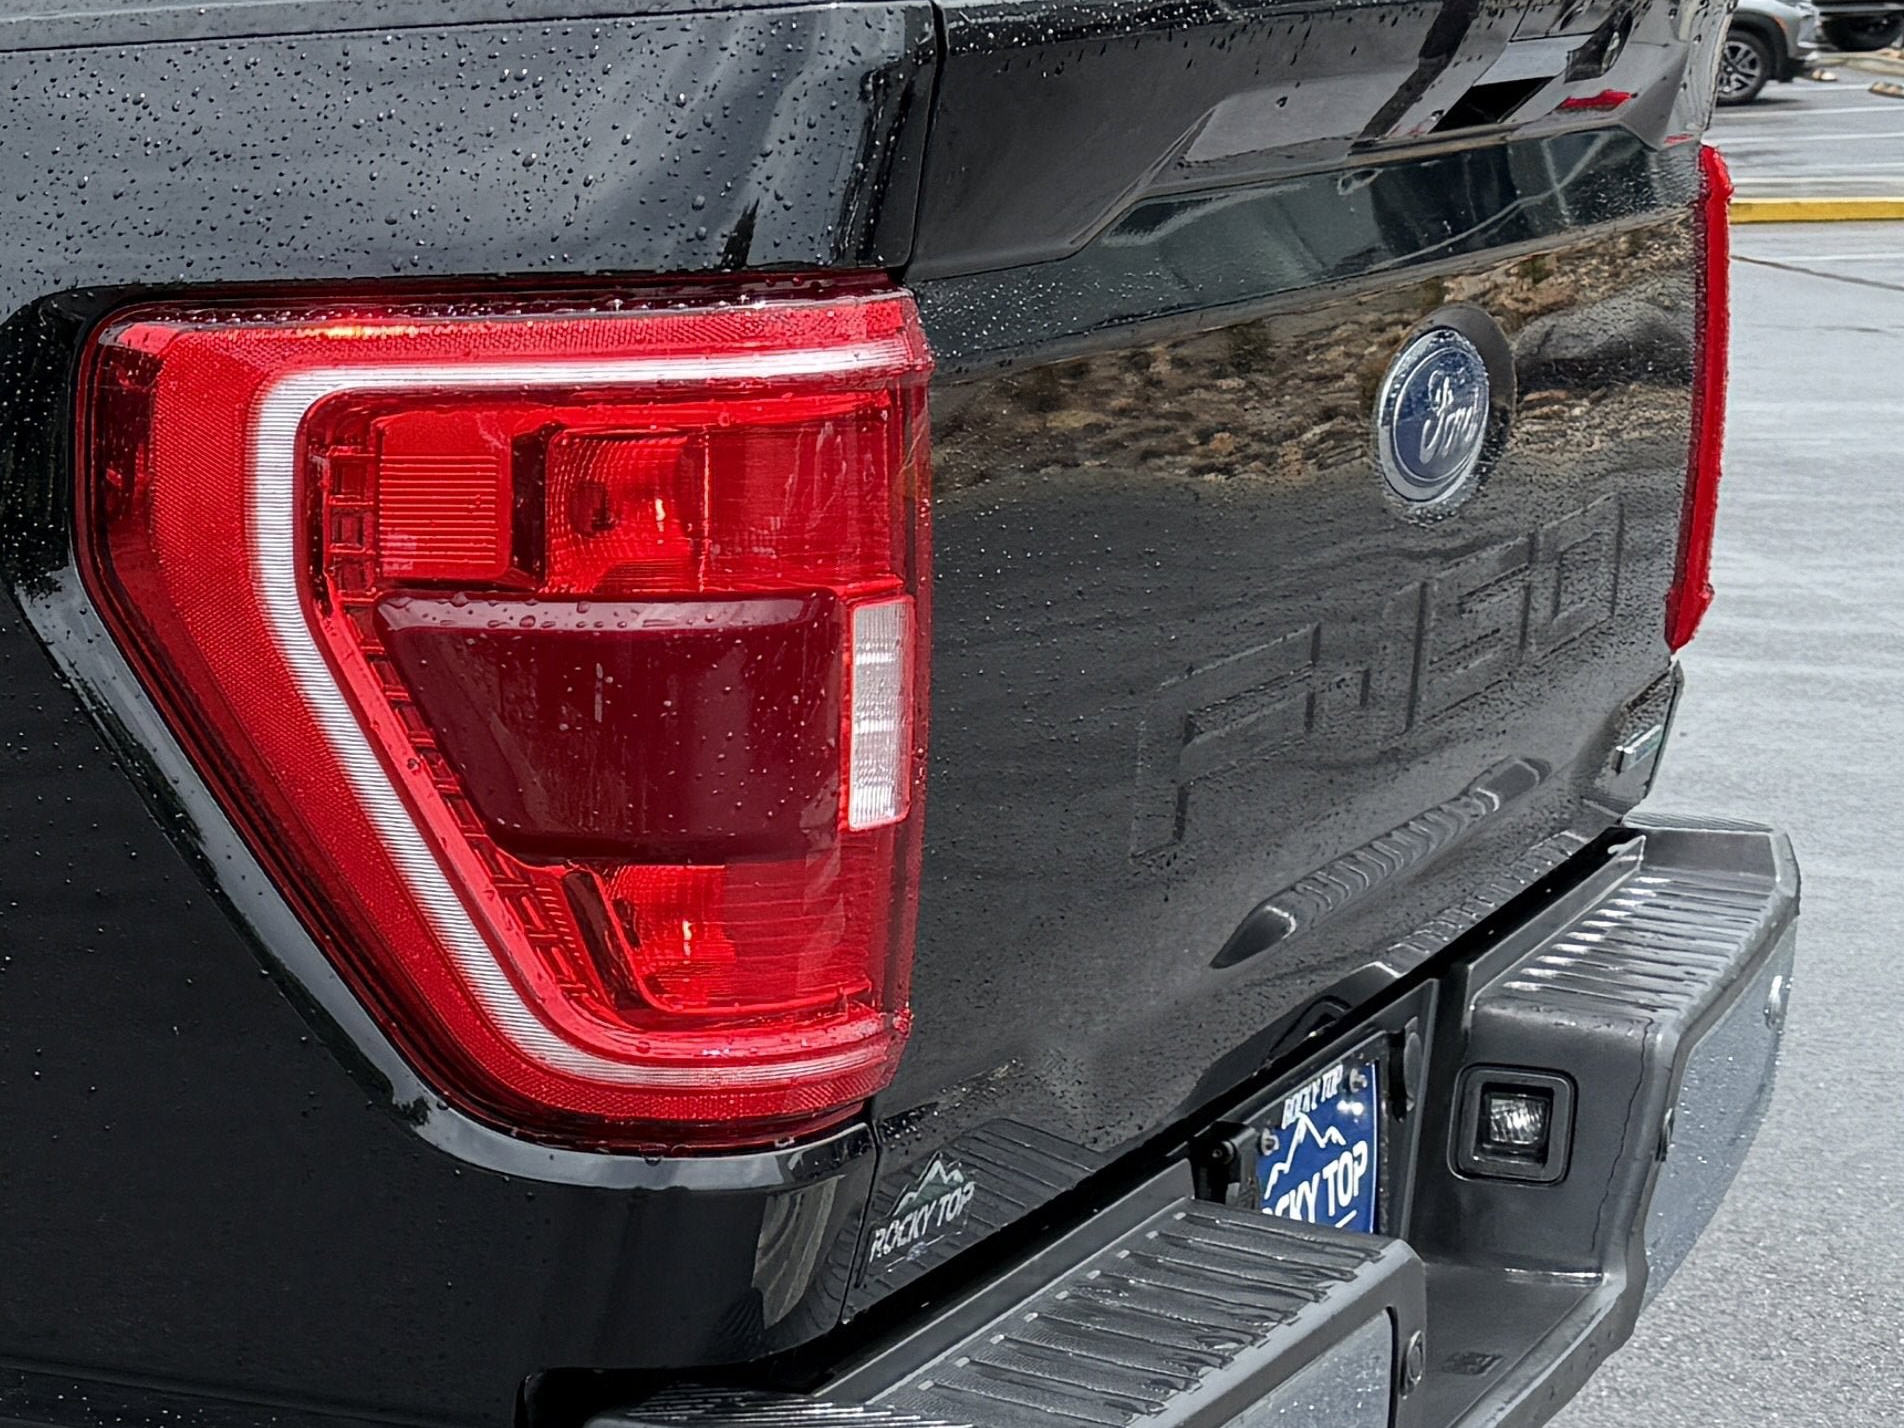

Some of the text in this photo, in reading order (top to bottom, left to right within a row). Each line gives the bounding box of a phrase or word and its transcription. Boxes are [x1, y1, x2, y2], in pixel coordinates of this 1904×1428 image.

[1322, 1140, 1368, 1217] TOP
[869, 1181, 975, 1262] ROCKY TOP
